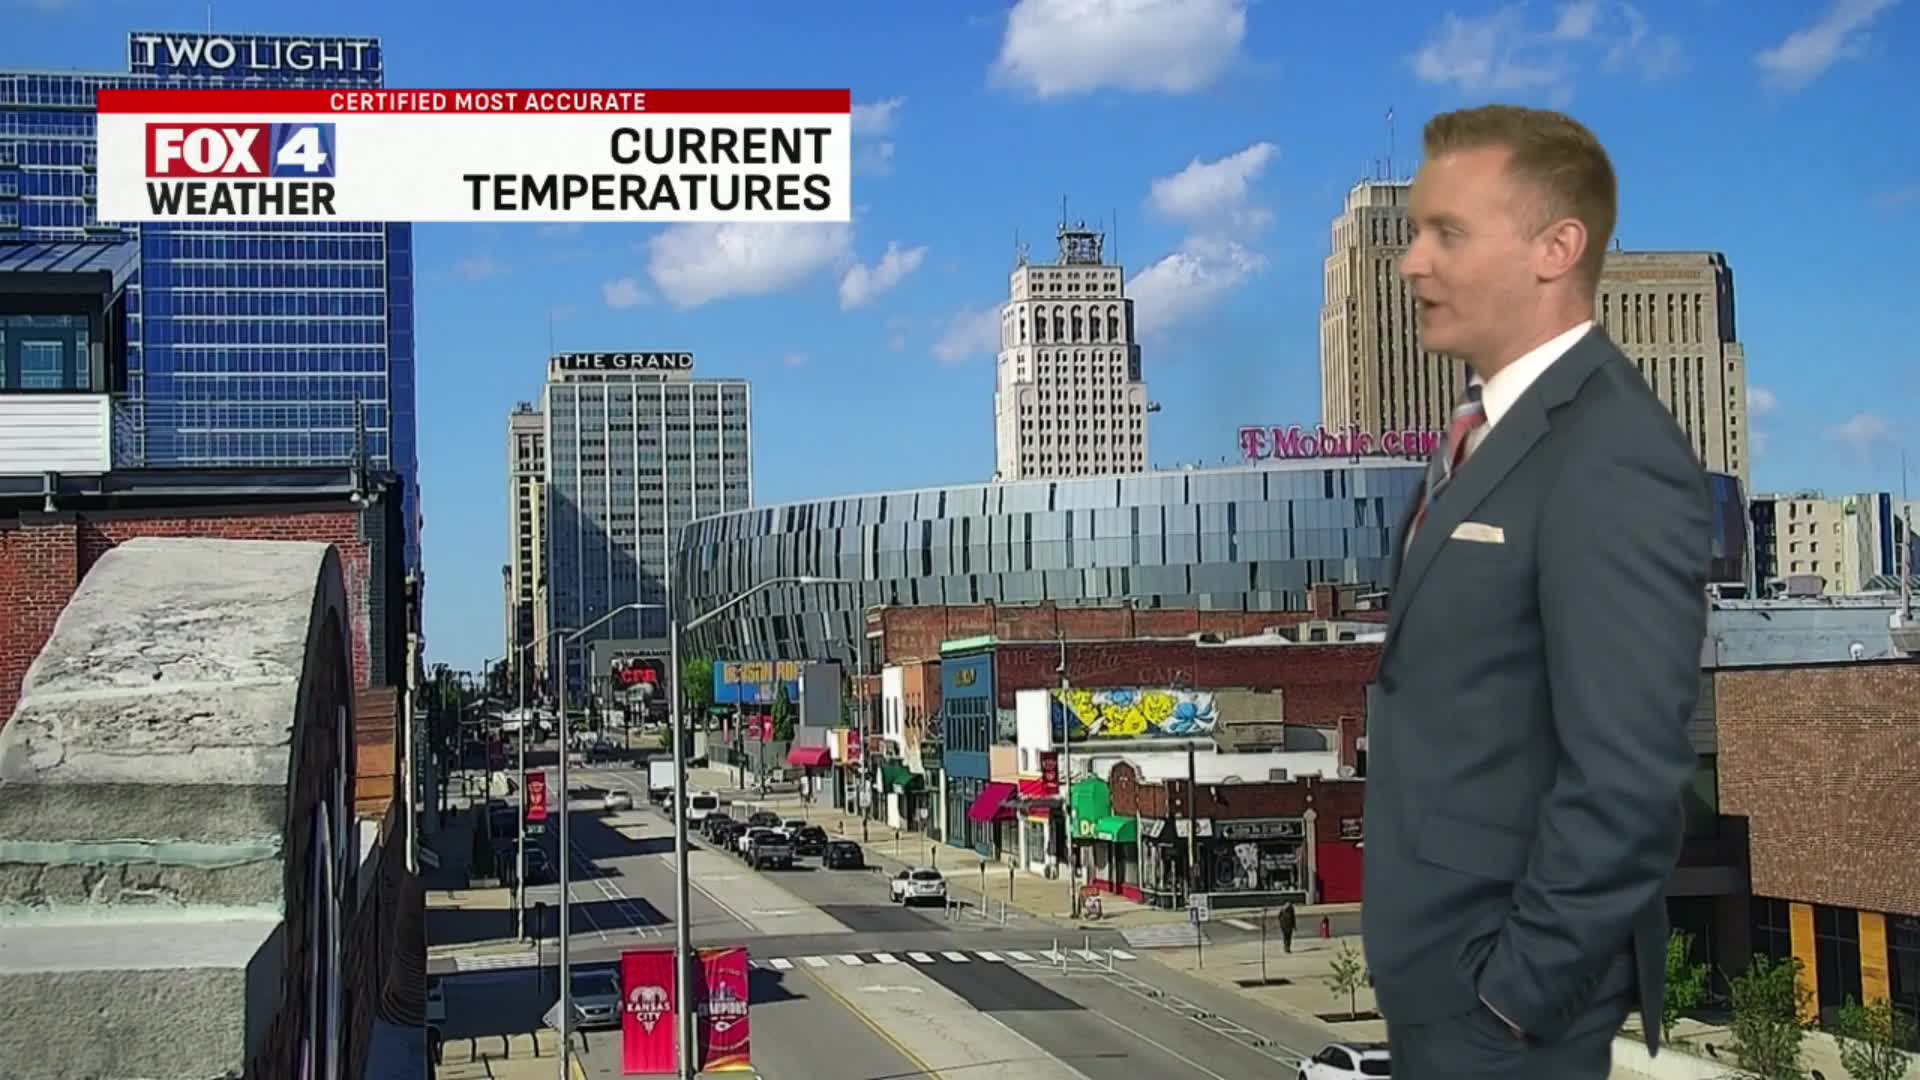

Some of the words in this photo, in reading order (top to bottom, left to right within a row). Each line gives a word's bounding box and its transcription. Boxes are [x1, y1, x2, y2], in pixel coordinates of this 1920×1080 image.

[137, 37, 236, 69] TWO
[250, 40, 370, 71] LIGHT
[562, 354, 606, 367] THE
[612, 354, 693, 368] GRAND
[1380, 431, 1446, 457] CEN
[626, 1002, 671, 1012] KANSAS
[636, 1013, 662, 1021] CITY
